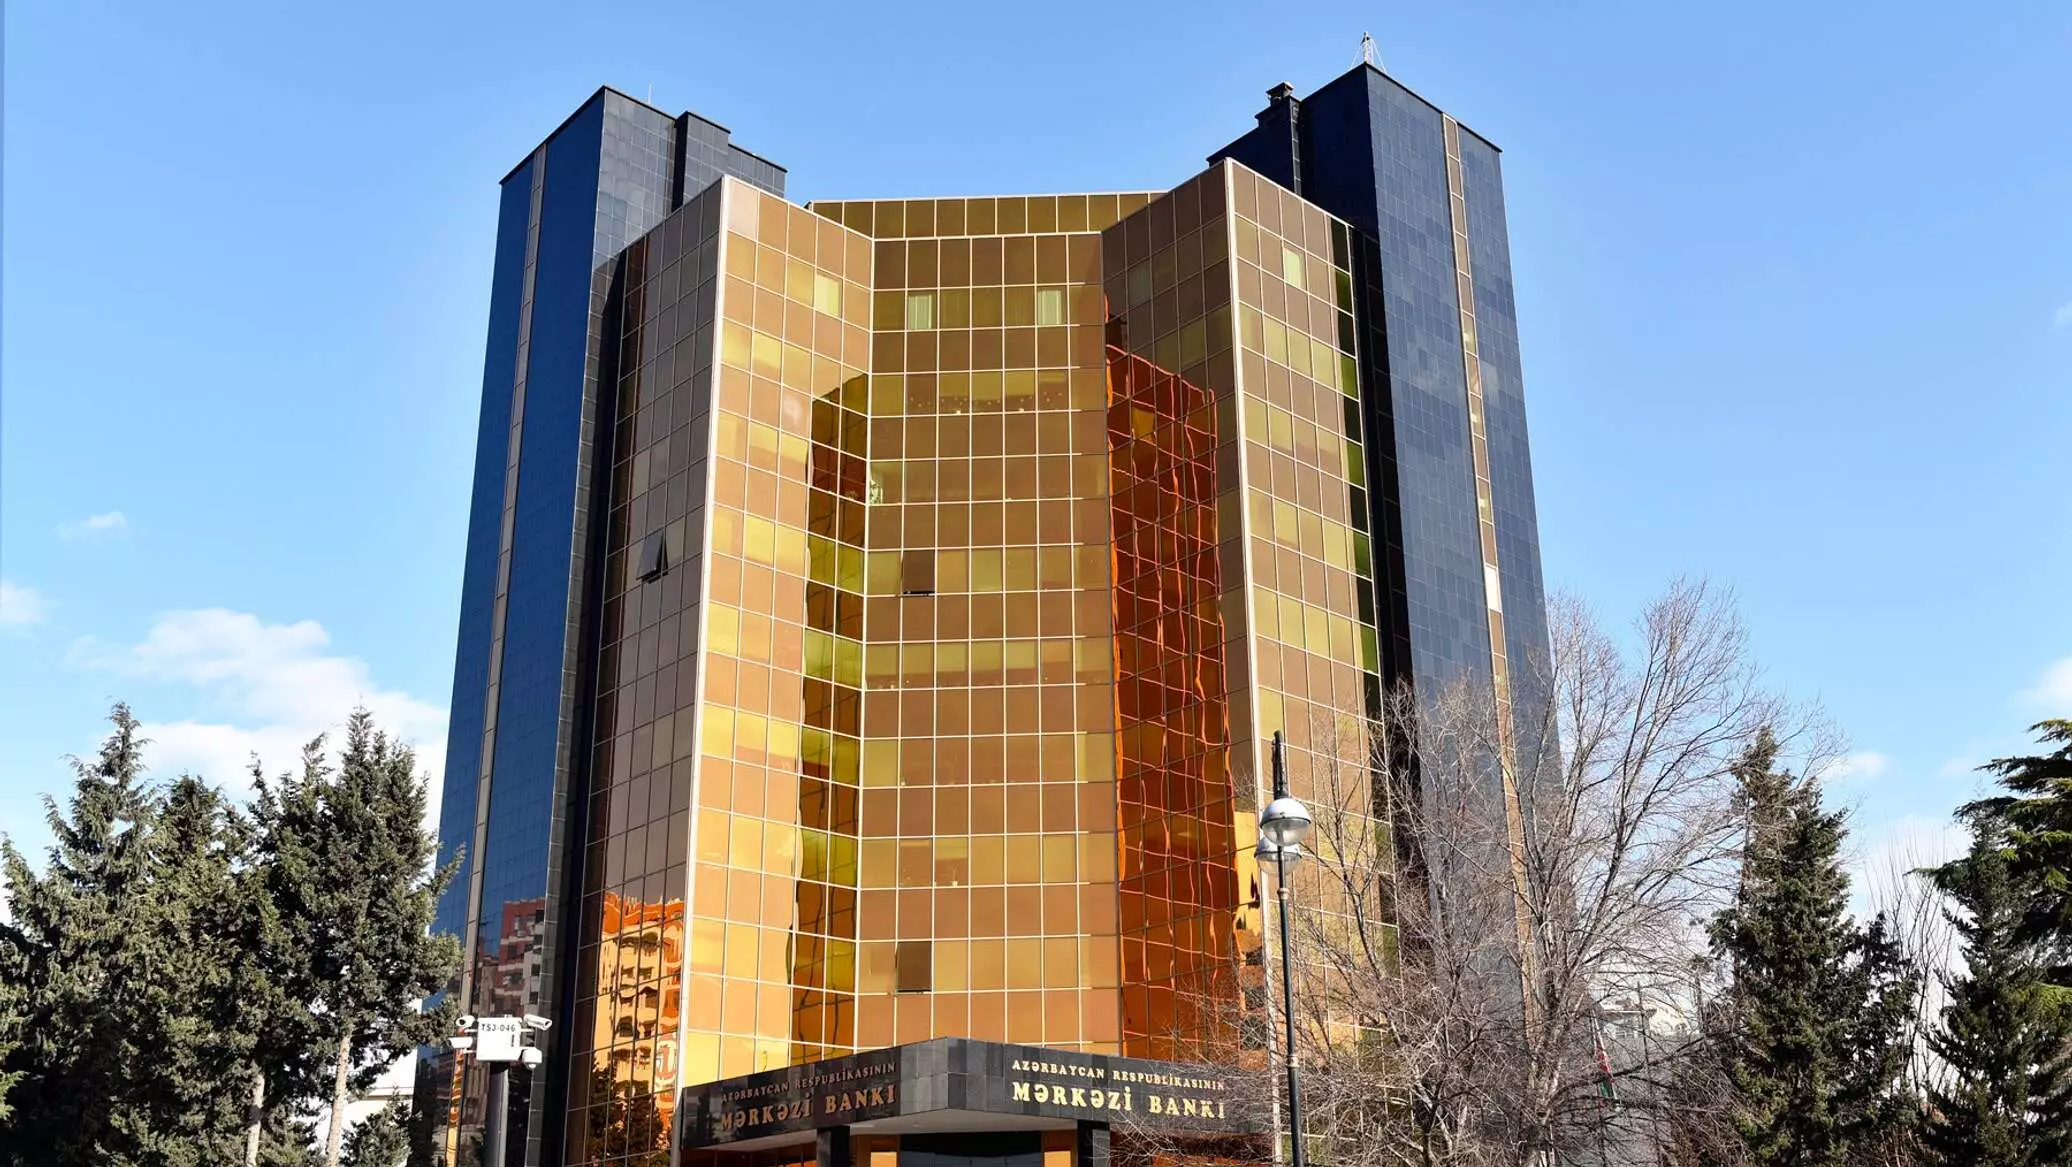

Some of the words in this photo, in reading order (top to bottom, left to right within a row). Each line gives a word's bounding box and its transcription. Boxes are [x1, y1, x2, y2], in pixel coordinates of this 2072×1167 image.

[795, 1062, 896, 1088] RESPUBLİKASININ
[1012, 1060, 1104, 1079] AZƏRBAYCAN
[1113, 1070, 1225, 1090] RESPUBLİKASININ
[721, 1093, 813, 1130] MƏRKƏZİ
[825, 1085, 896, 1114] BANKI
[1012, 1081, 1132, 1111] MƏRKƏZİ
[1149, 1095, 1225, 1119] BANKI
